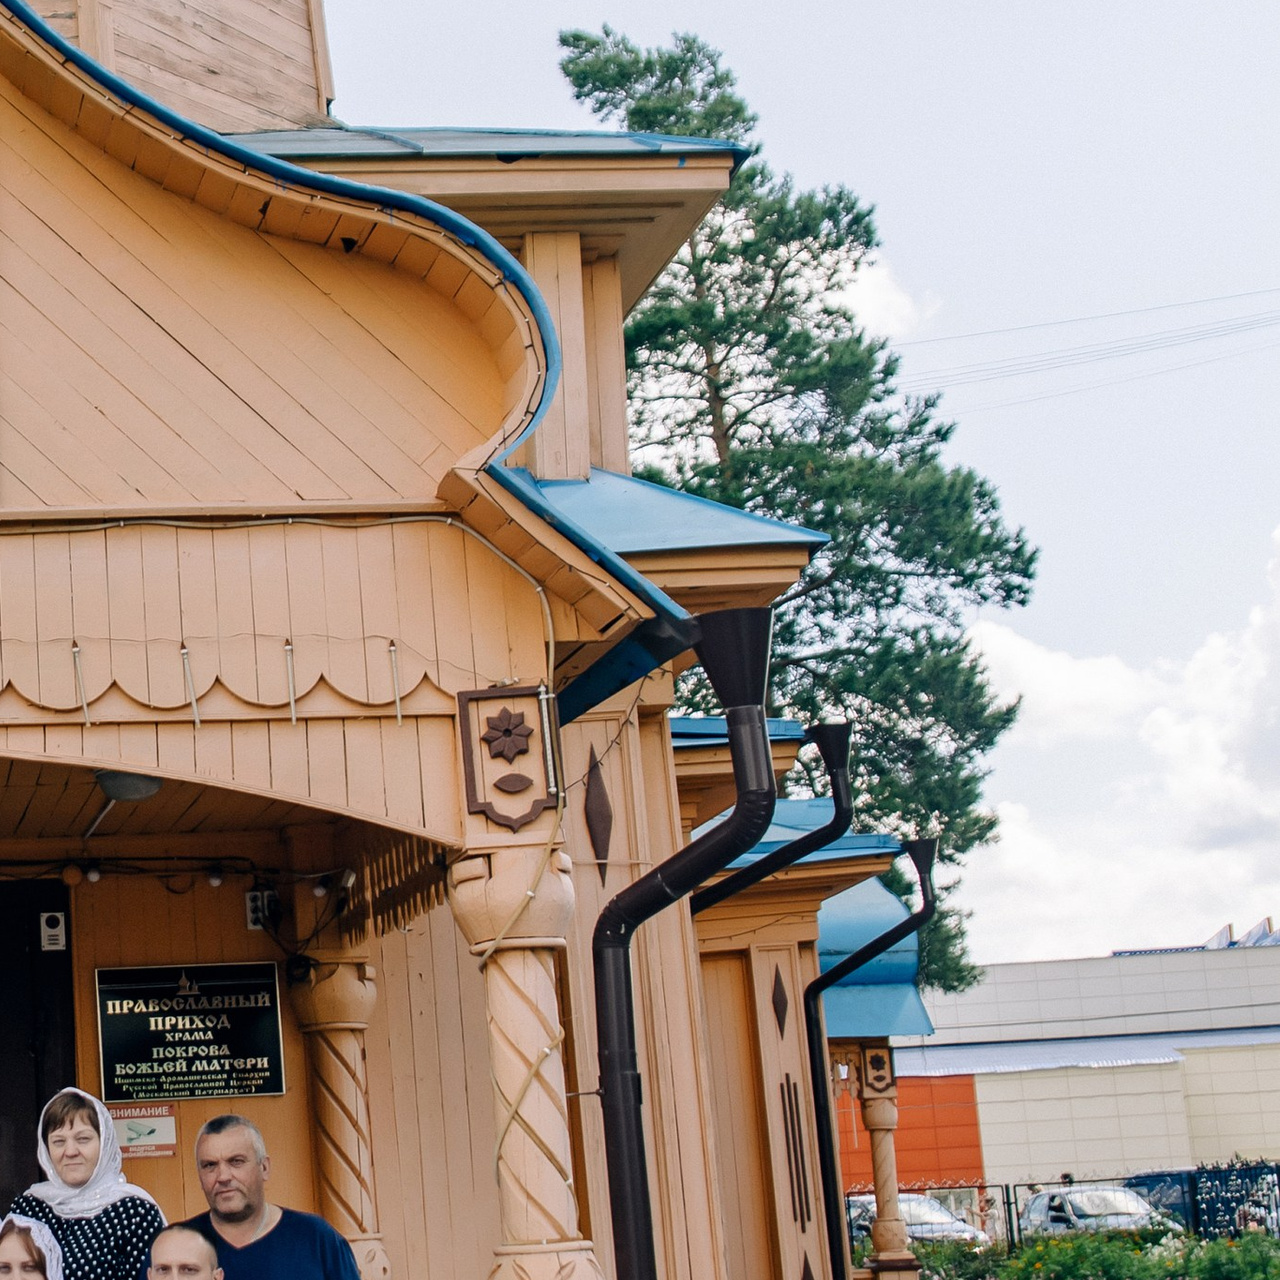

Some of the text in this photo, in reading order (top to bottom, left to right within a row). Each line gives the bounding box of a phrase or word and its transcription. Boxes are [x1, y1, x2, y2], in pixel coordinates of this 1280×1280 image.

[106, 991, 271, 1014] ПРАВОСЛАВНЫЙ
[149, 1014, 231, 1031] ПРИХОД
[165, 1031, 214, 1042] ХРАМА
[152, 1044, 231, 1059] ПОКРОВА
[114, 1057, 269, 1075] БОЖЬЕЙ МАТЕРИ
[109, 1106, 170, 1118] ВНИМАНИЕ
